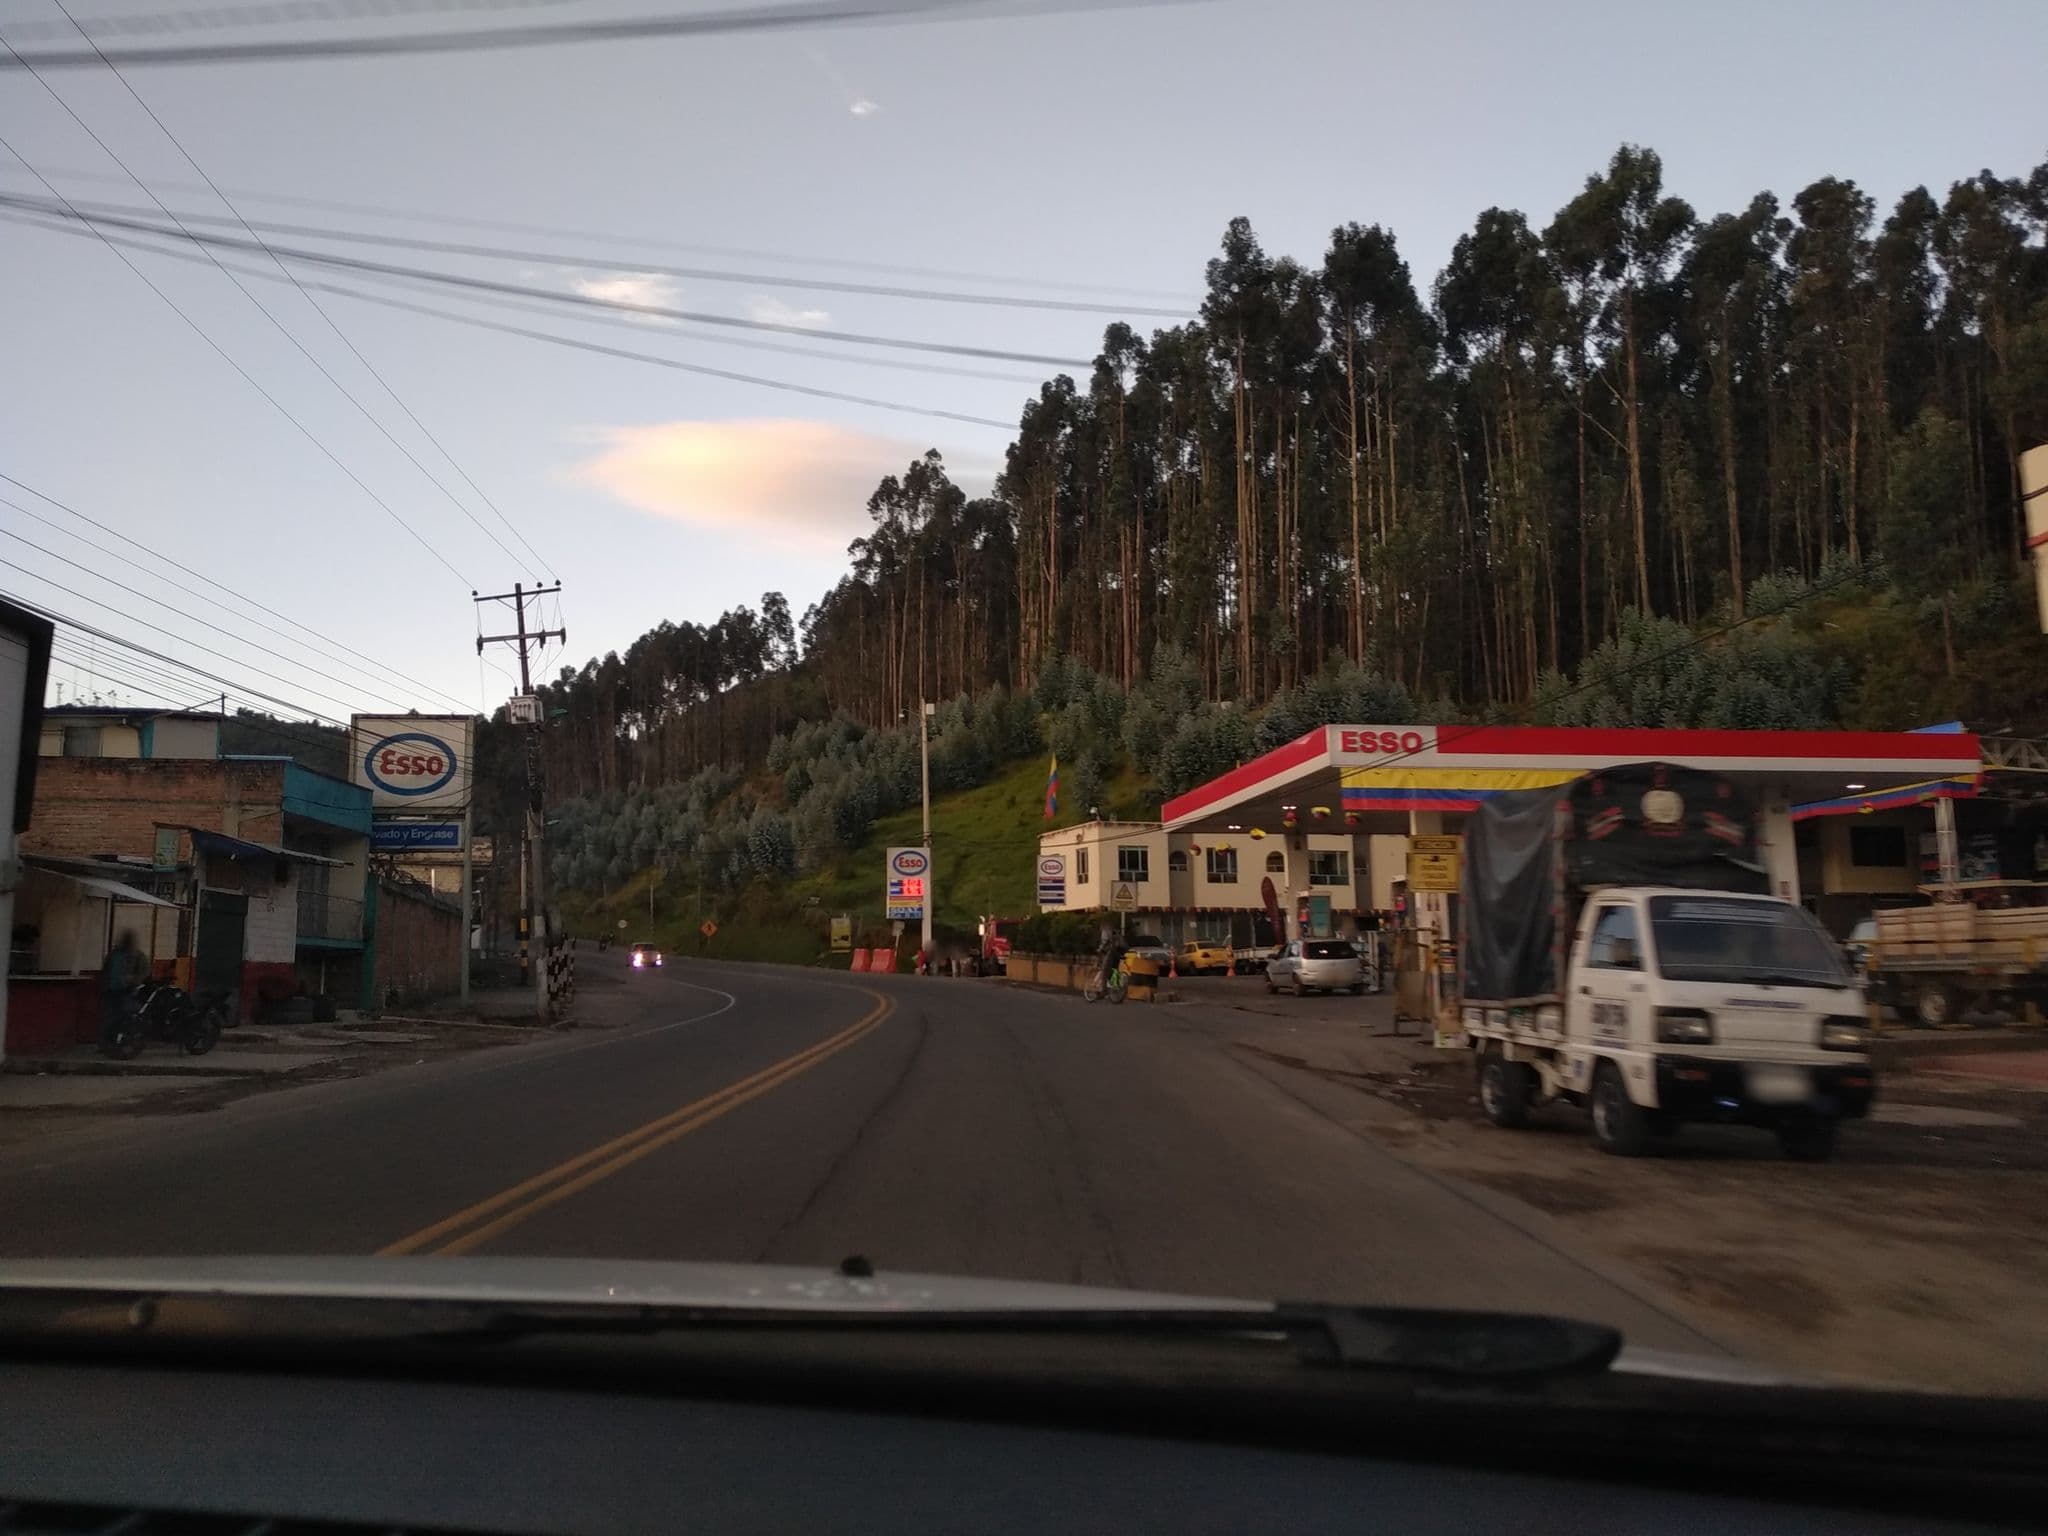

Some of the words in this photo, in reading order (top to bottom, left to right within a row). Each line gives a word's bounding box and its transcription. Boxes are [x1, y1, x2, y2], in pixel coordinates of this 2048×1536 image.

[1341, 731, 1423, 754] ESSO
[380, 749, 443, 775] Esso
[375, 829, 401, 839] vado
[403, 831, 410, 840] y
[411, 828, 454, 841] Engrase
[898, 857, 923, 868] Esso
